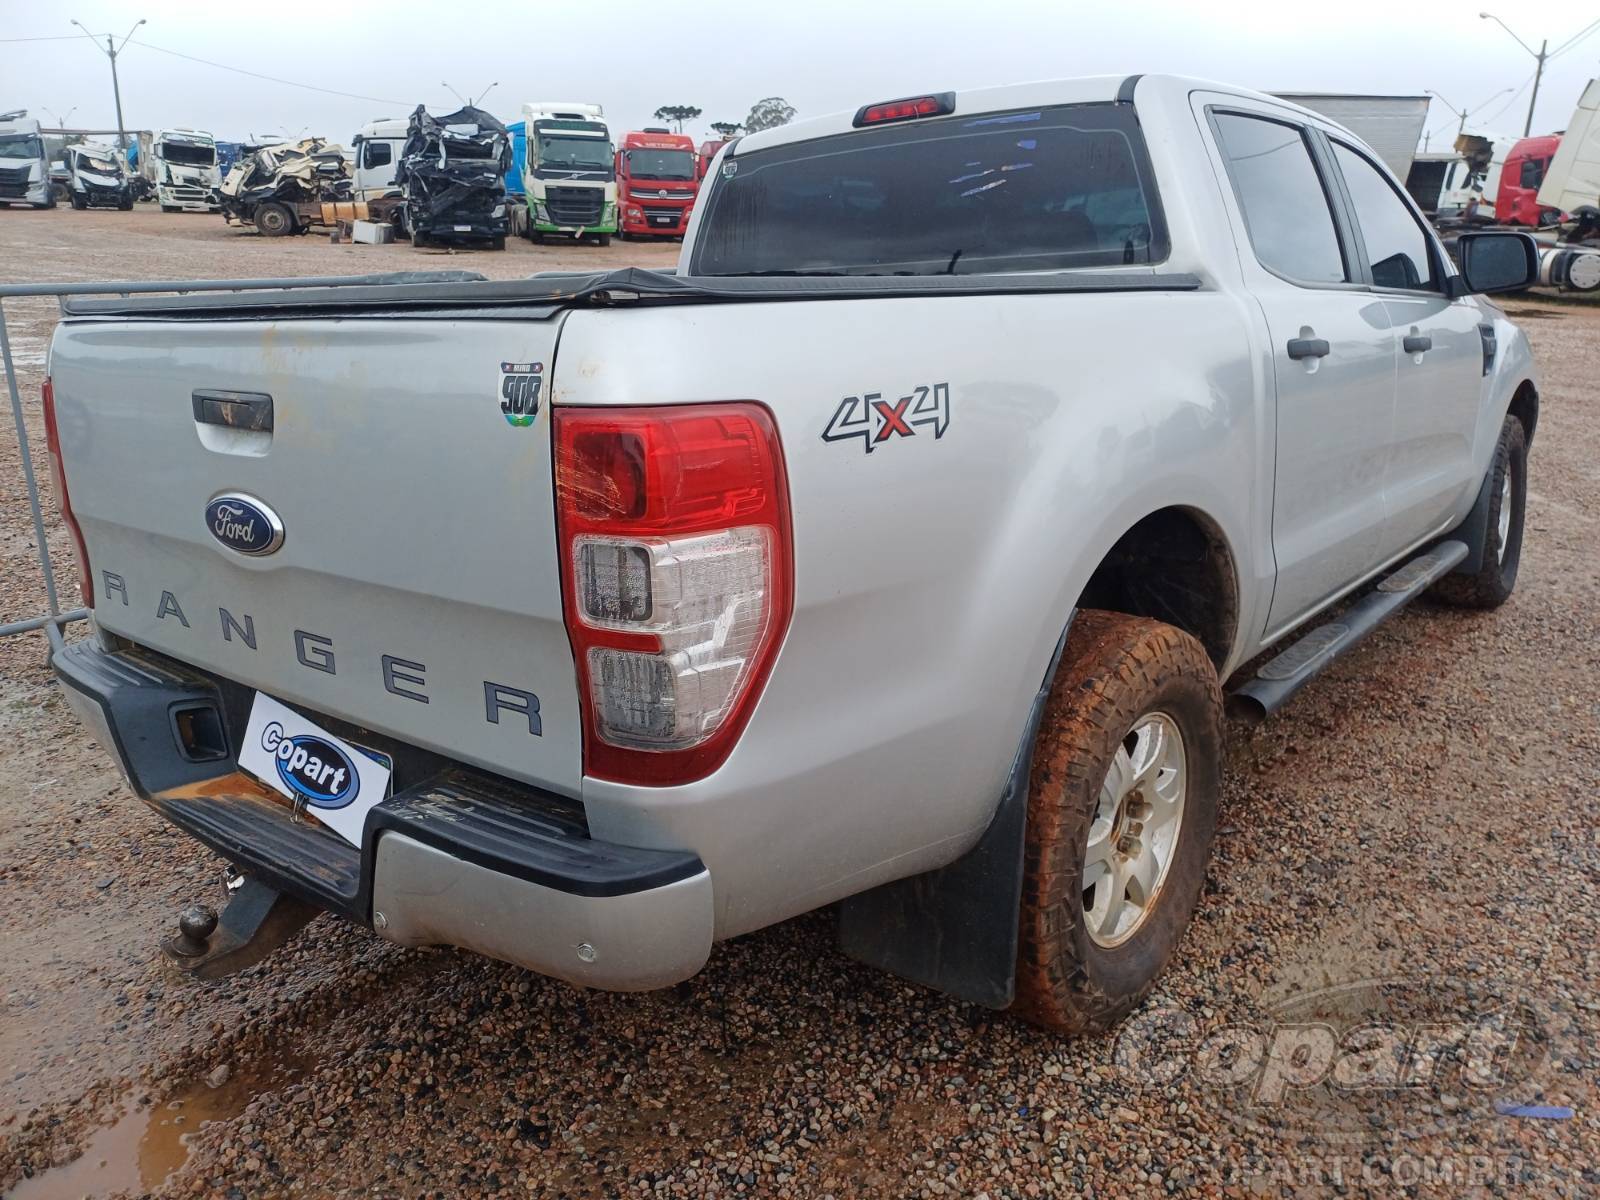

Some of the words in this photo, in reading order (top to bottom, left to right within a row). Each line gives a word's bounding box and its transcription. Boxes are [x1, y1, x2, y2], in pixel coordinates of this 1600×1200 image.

[215, 505, 255, 543] Ford
[102, 570, 542, 738] RANGER
[261, 721, 346, 795] Copart
